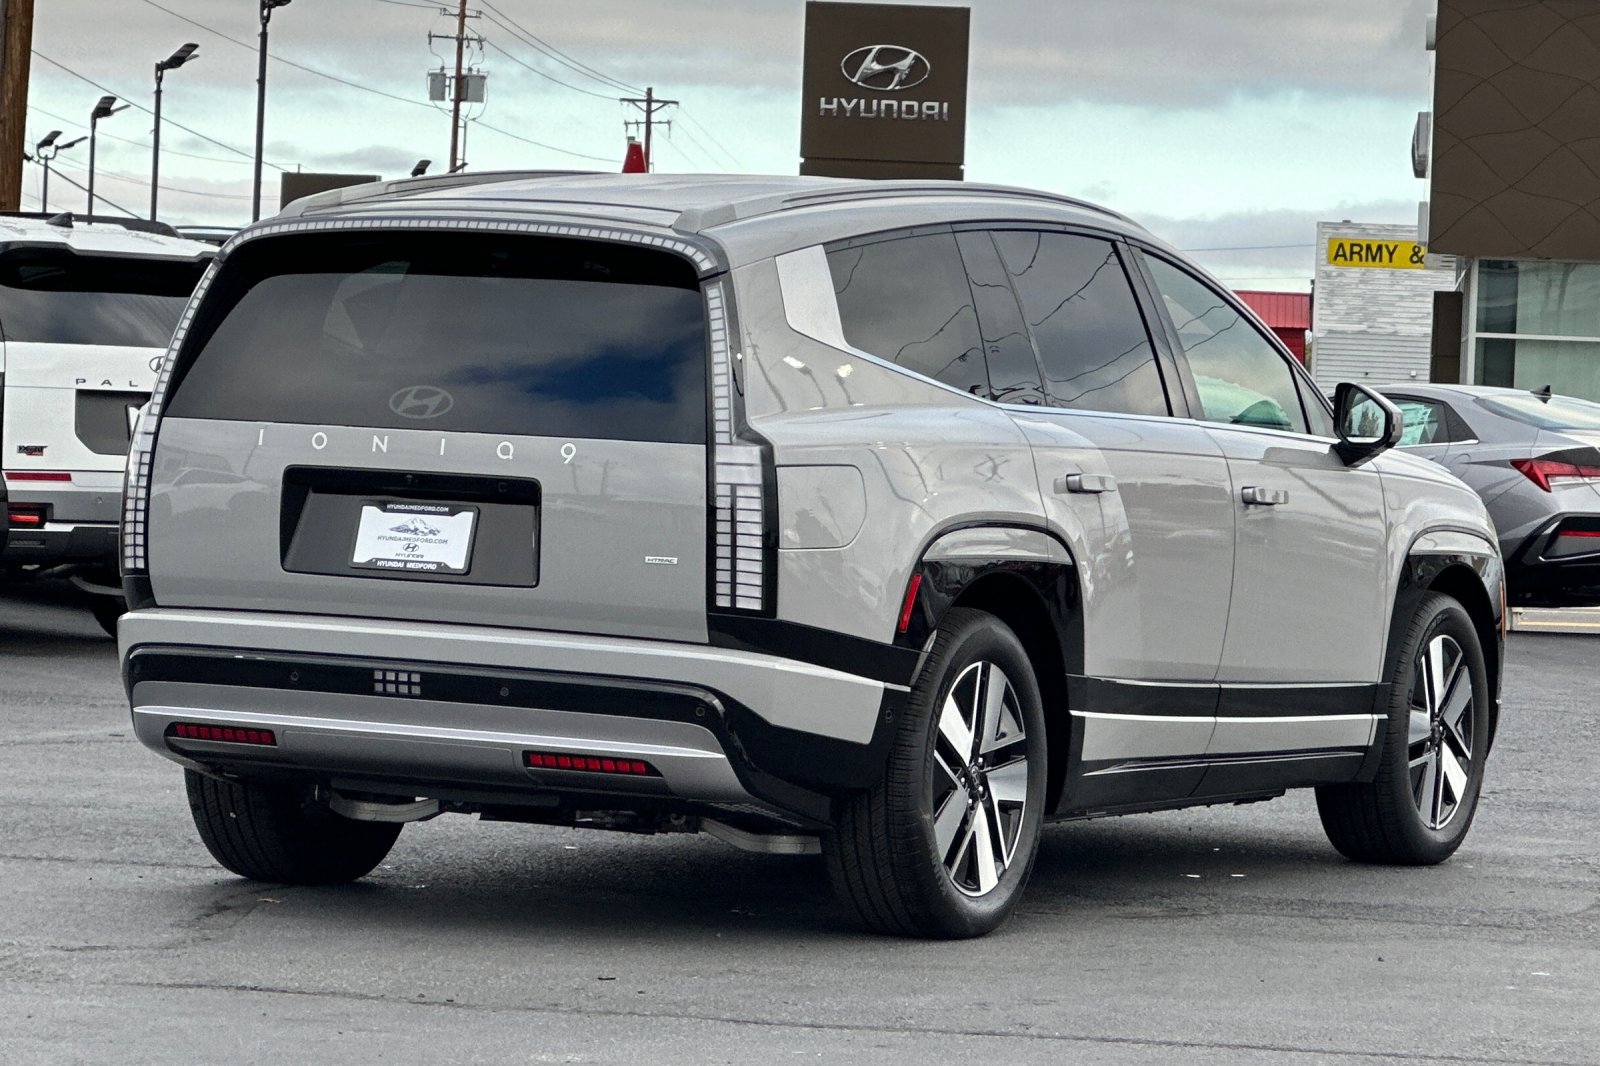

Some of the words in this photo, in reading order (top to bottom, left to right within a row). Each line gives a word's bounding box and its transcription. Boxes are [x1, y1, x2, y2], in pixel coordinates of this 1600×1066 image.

[820, 96, 949, 121] HYUNDAI
[1332, 242, 1399, 263] ARMY
[1409, 245, 1424, 264] &
[386, 503, 449, 512] HYUNDAIMEDFORD.COM
